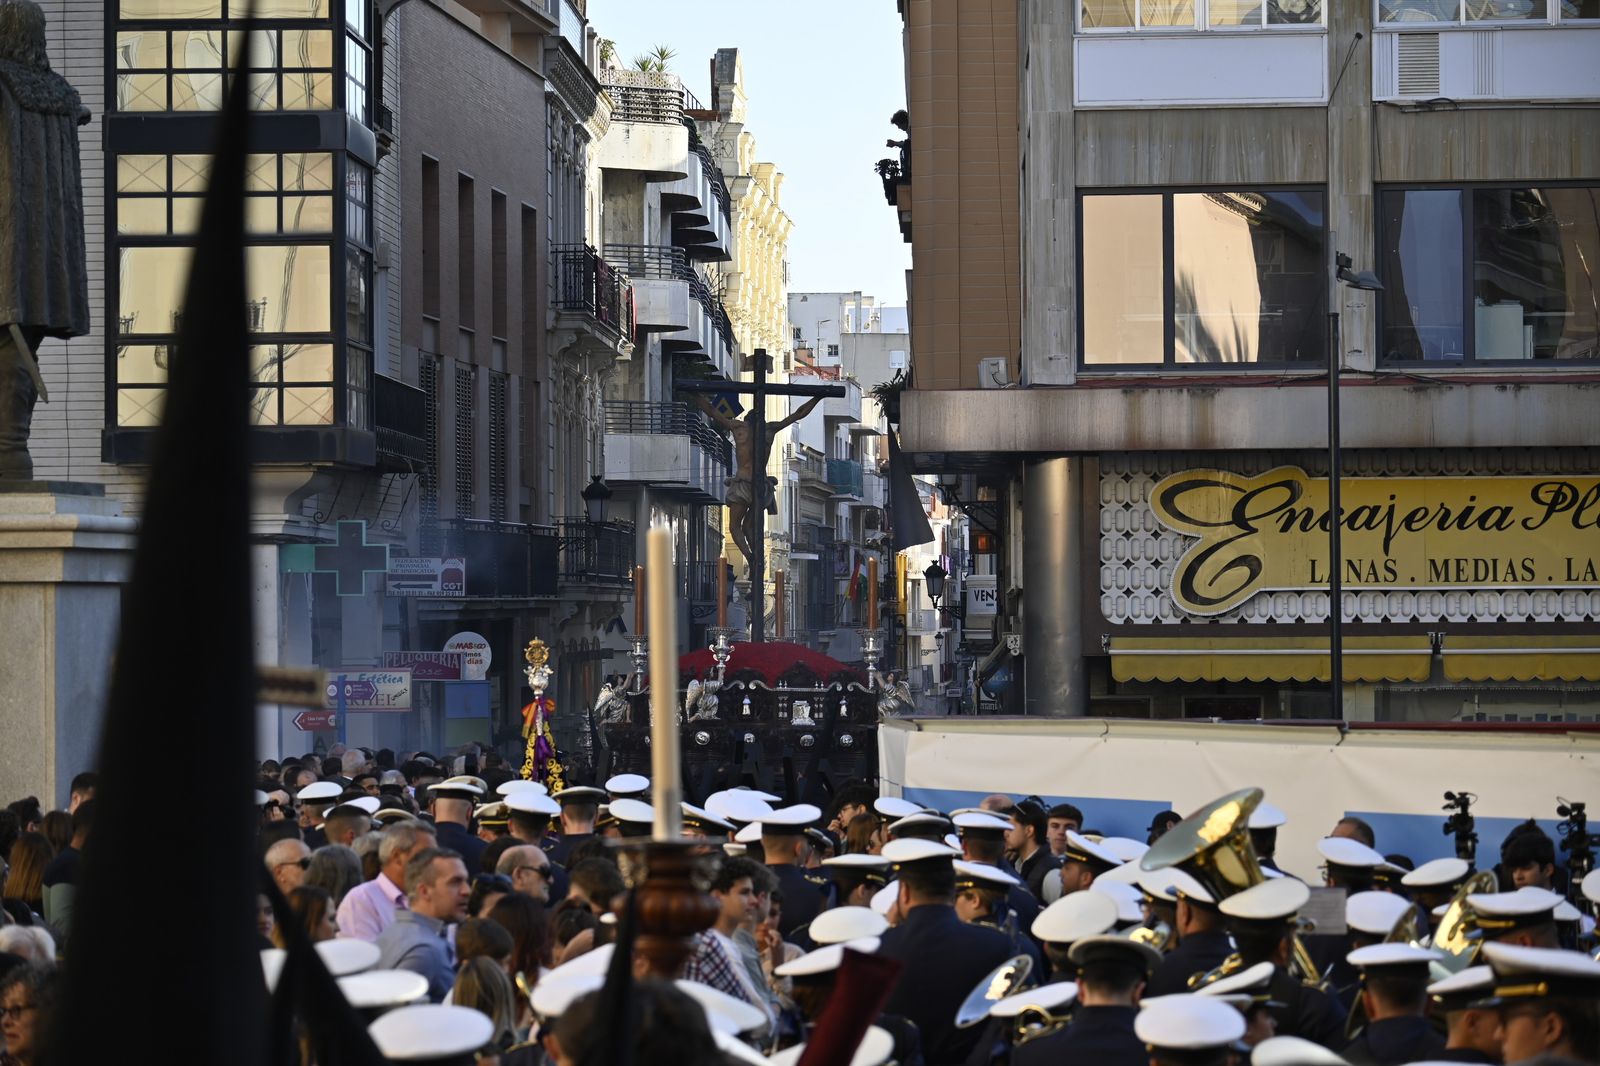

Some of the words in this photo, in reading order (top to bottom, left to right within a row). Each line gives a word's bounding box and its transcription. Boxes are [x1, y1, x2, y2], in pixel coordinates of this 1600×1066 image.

[1159, 479, 1515, 606] Encajeria
[1521, 481, 1600, 531] Pl
[1428, 557, 1536, 583] MEDIAS
[1564, 557, 1598, 582] LA
[442, 582, 463, 590] CGT
